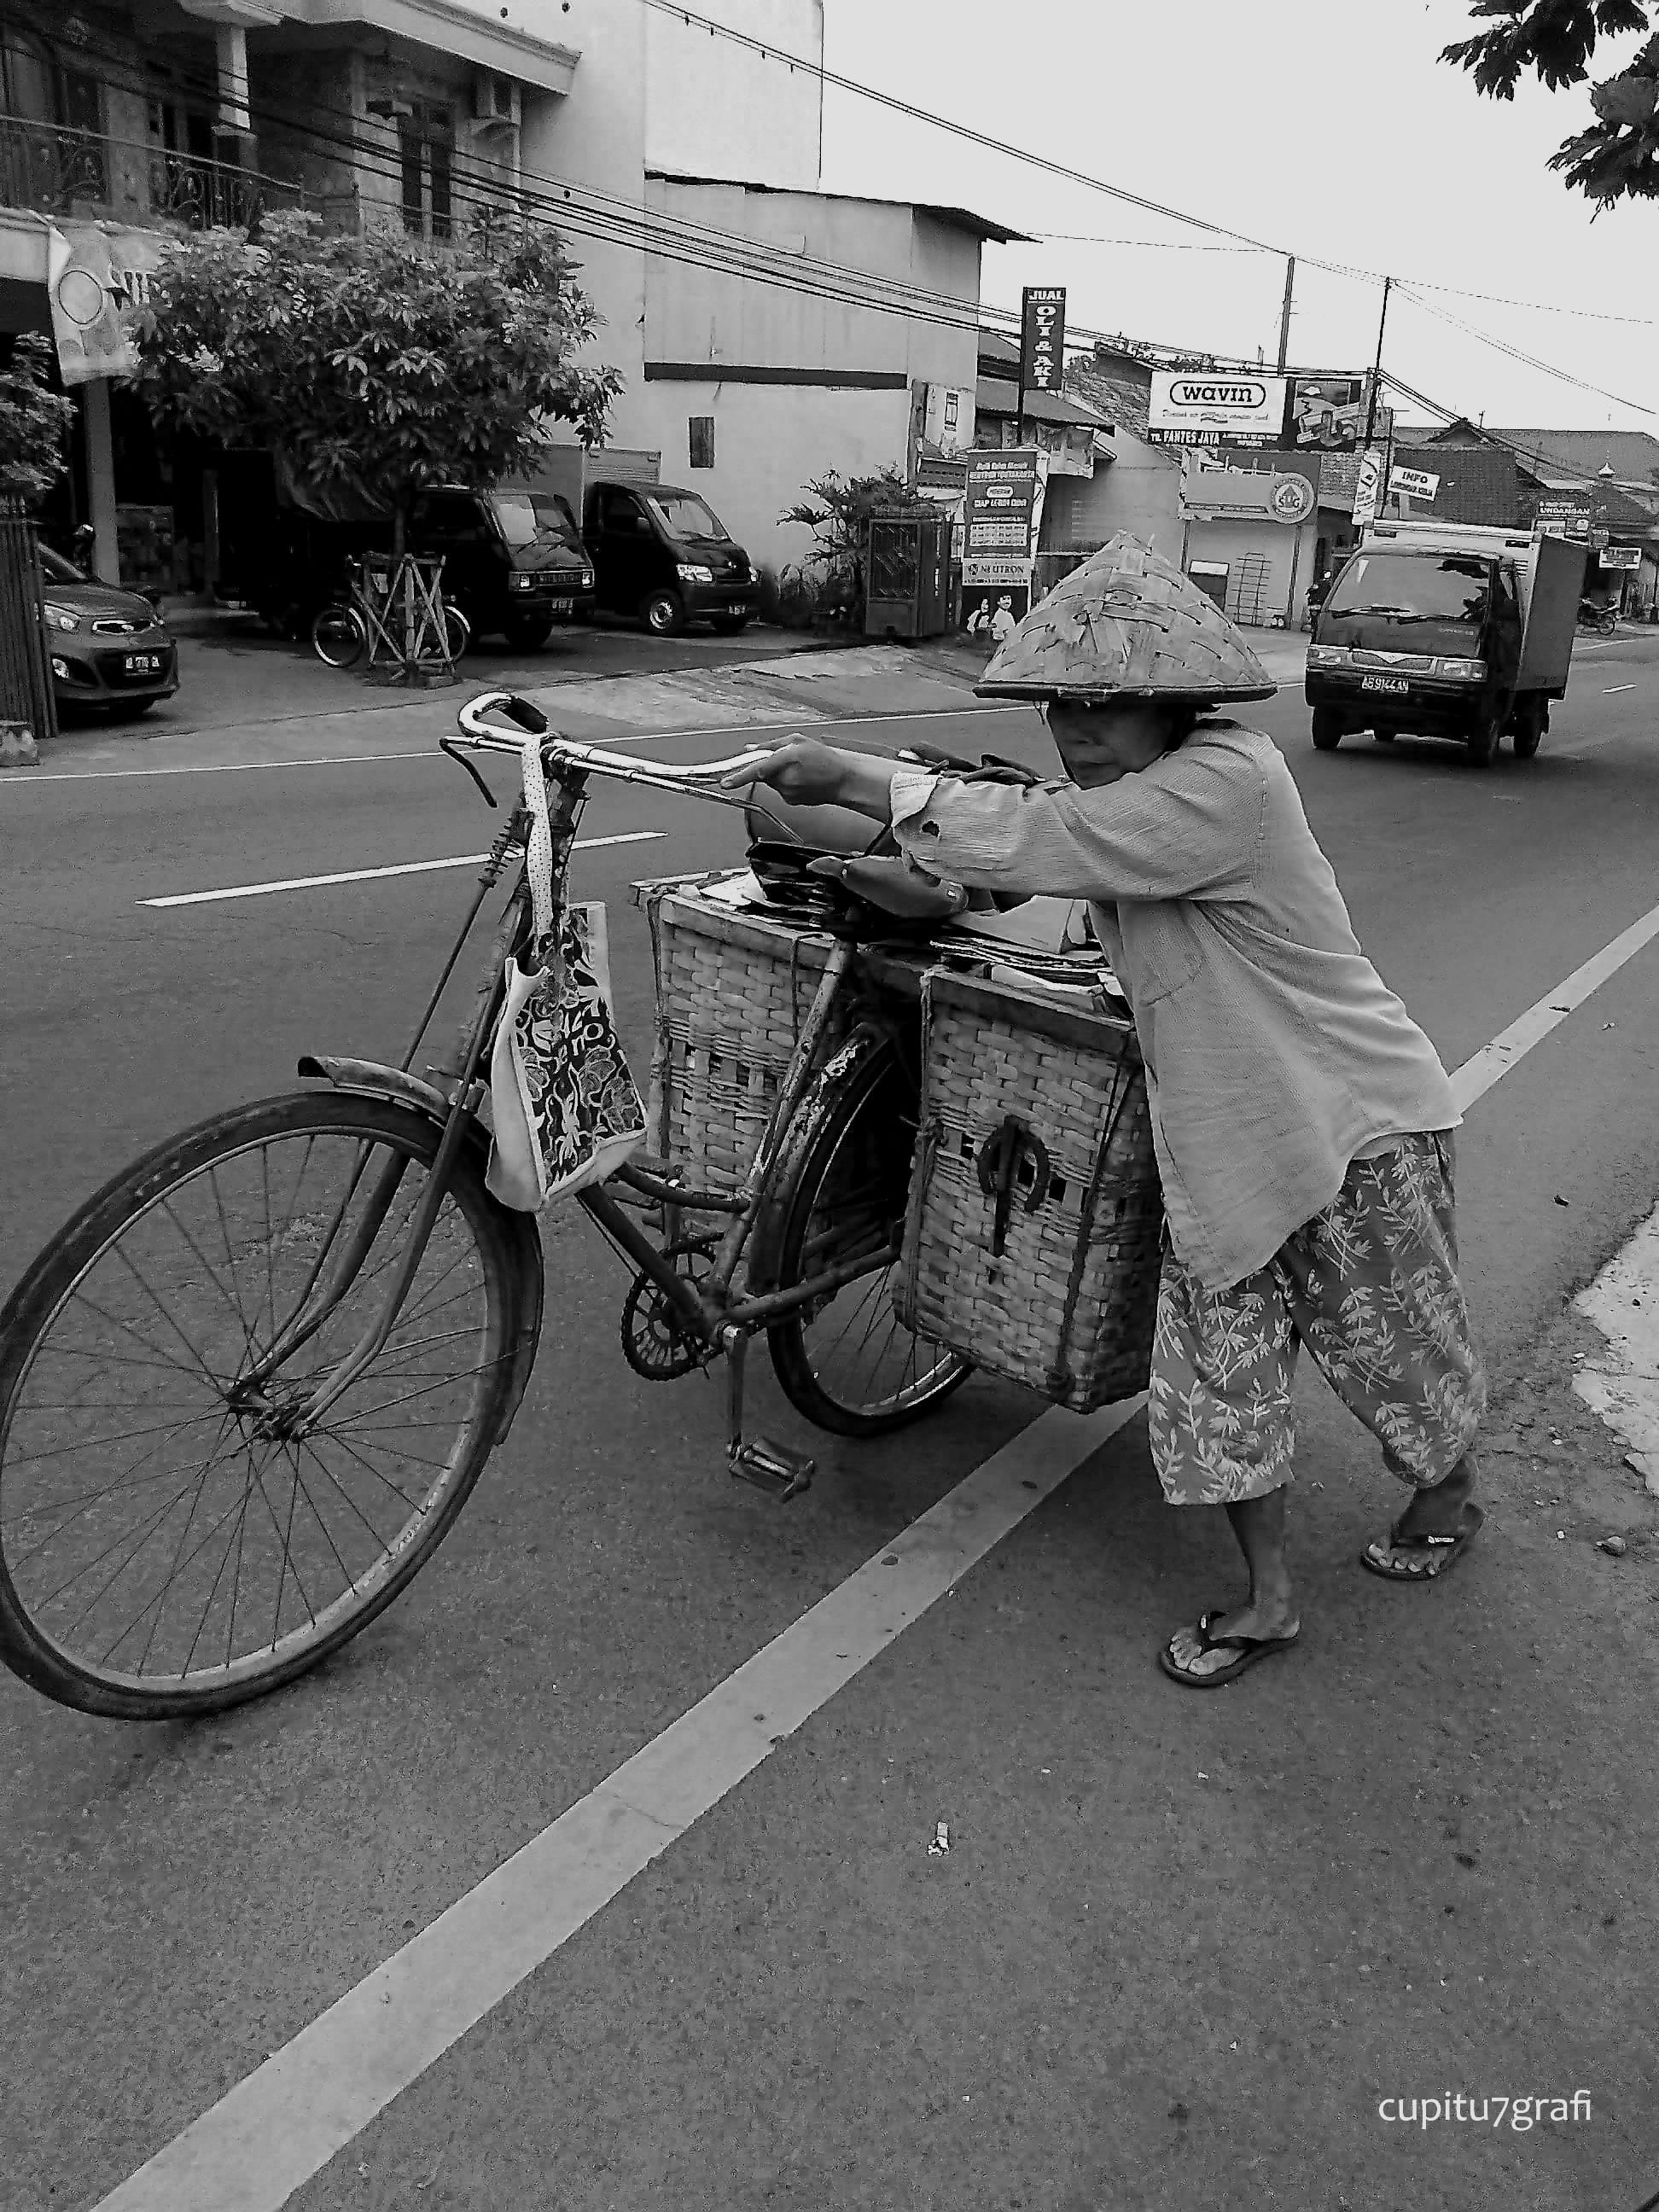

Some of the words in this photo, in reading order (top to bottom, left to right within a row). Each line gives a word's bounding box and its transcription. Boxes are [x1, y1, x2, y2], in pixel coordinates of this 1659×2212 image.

[1028, 290, 1064, 300] JUAL
[1183, 387, 1252, 402] wavin
[1402, 471, 1428, 484] INFO
